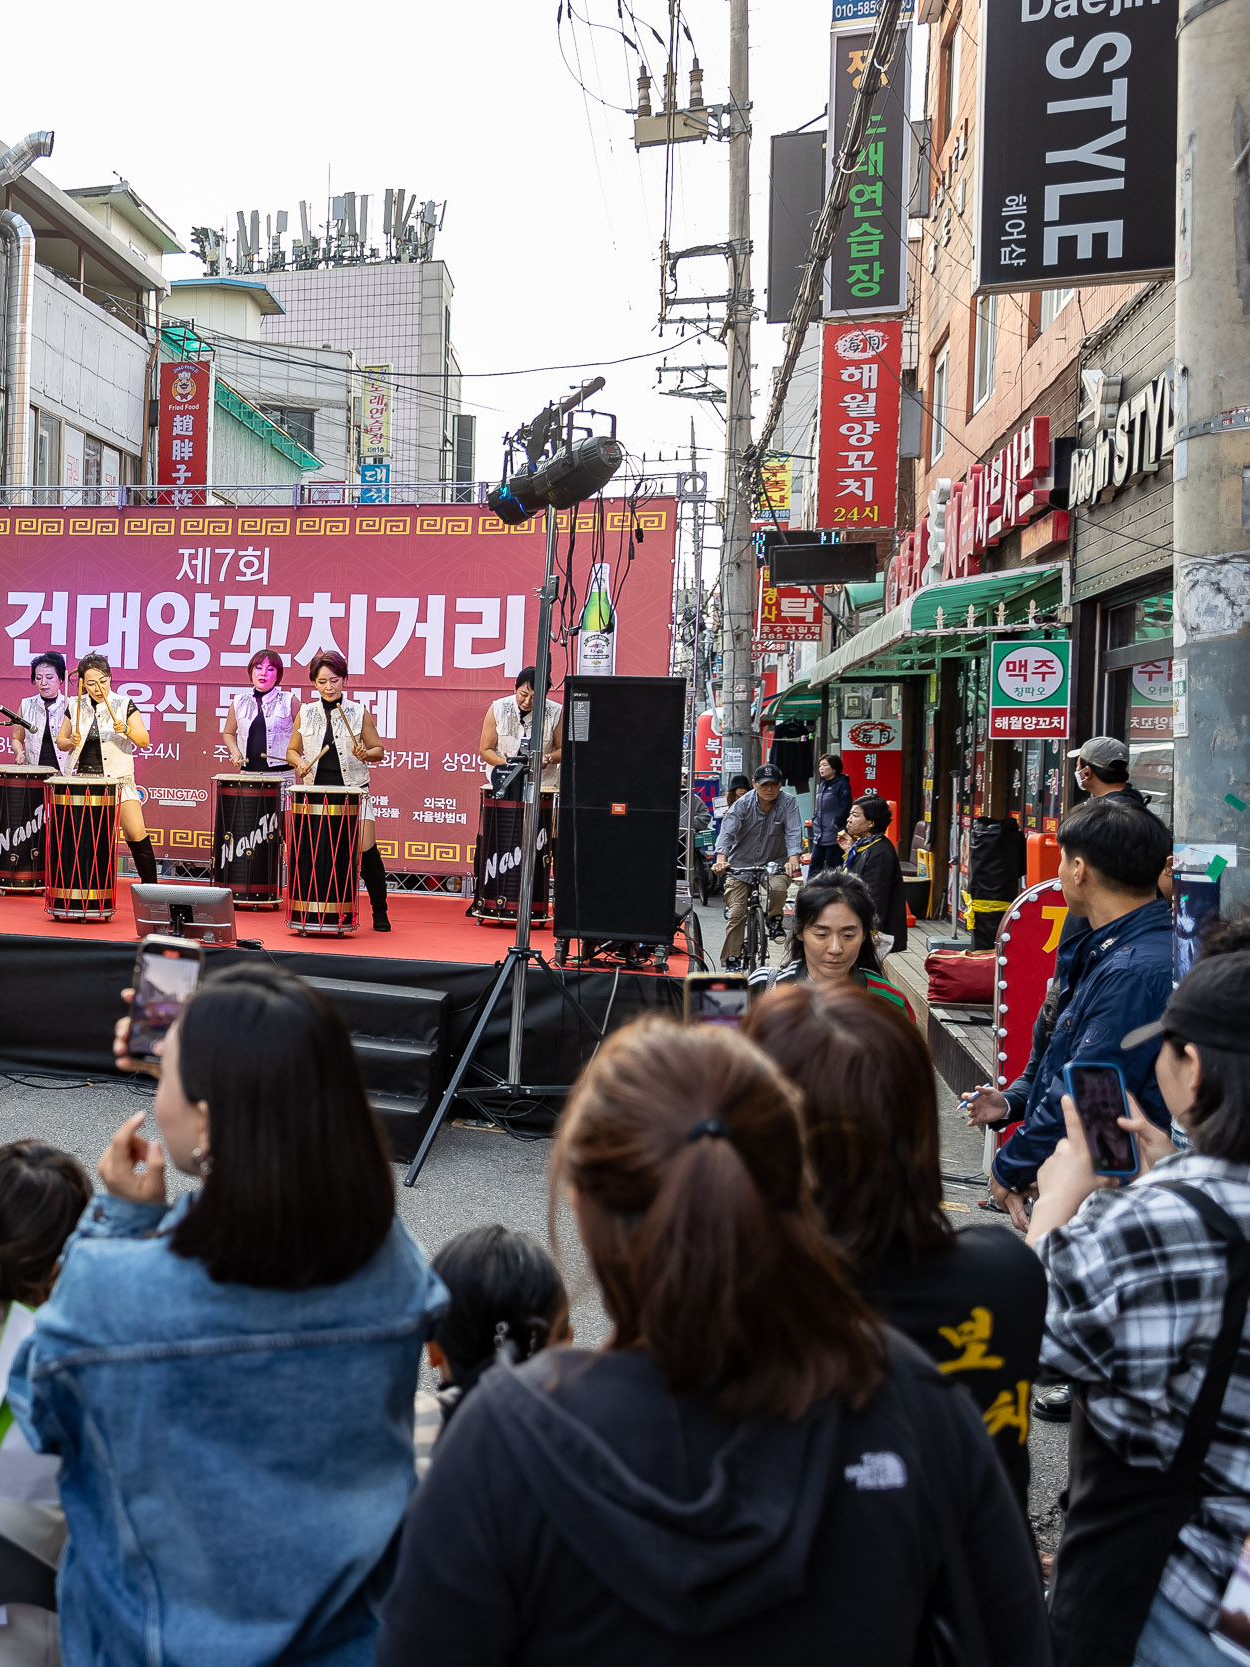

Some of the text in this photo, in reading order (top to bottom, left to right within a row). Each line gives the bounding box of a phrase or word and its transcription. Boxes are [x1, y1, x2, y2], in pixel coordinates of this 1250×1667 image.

[1043, 31, 1132, 266] STYLE
[1001, 194, 1027, 266] 헤어샵
[835, 363, 881, 502] 해월양꼬치
[833, 506, 879, 522] 24시
[175, 546, 270, 586] 제7회
[4, 591, 527, 678] 건대양꼬치거리
[1006, 659, 1057, 682] 맥주
[1013, 686, 1047, 697] 칭따오
[995, 716, 1064, 730] 해월양꼬치
[150, 788, 207, 800] TSINGTAO
[424, 798, 457, 810] 외국인
[412, 811, 467, 824] 자율방범대
